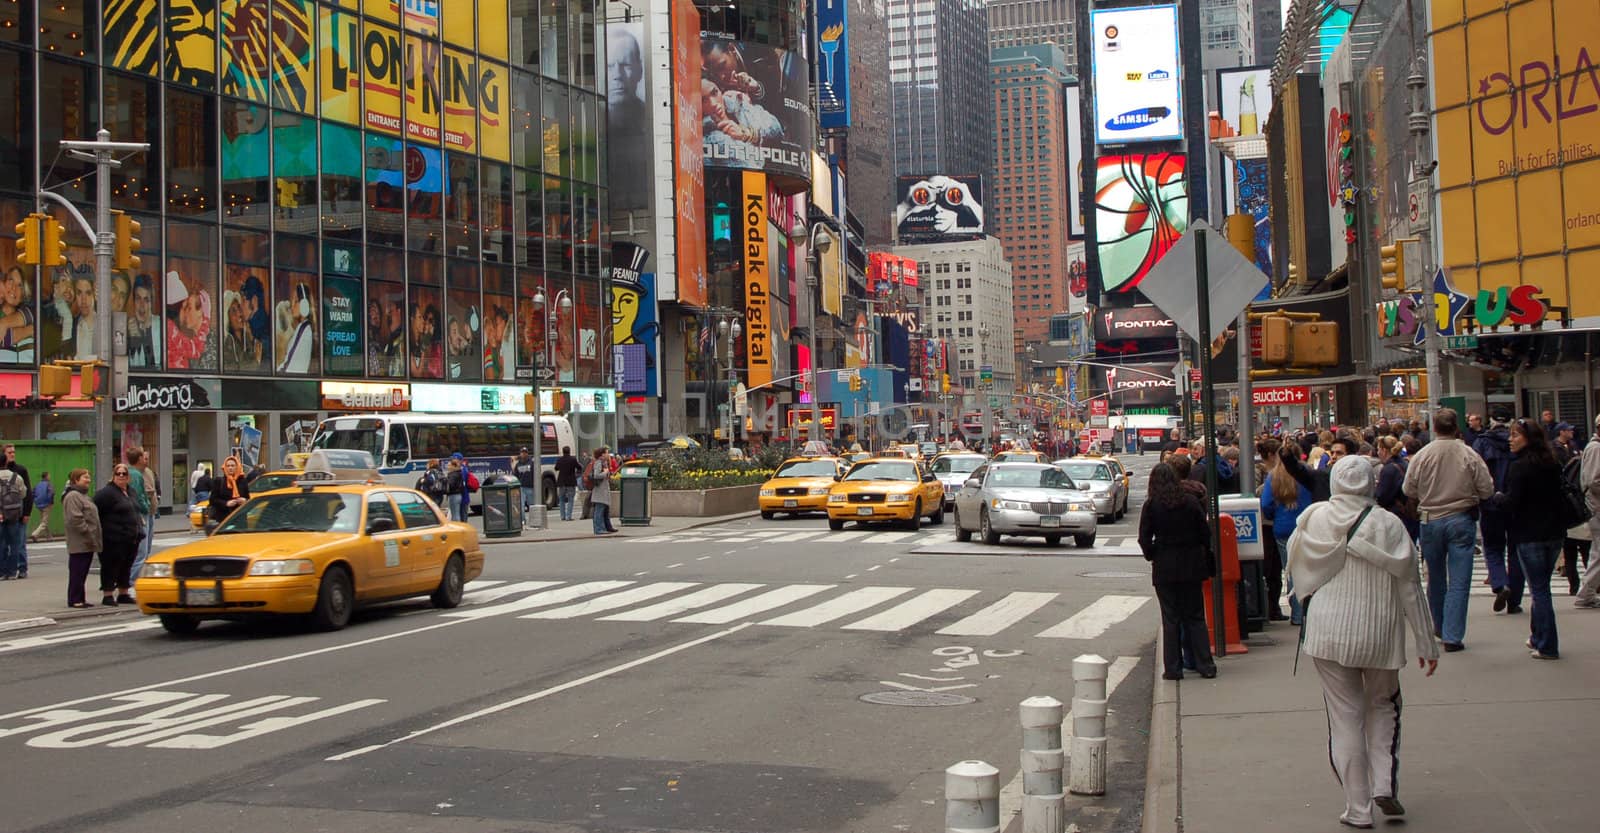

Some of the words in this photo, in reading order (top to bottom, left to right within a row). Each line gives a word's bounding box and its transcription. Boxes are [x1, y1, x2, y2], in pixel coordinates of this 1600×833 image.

[331, 11, 415, 92] LION
[421, 28, 499, 116] KING
[367, 112, 400, 129] ENTRANCE
[408, 123, 420, 135] ON
[422, 126, 438, 138] 45TH
[444, 132, 463, 145] STREET
[1498, 155, 1525, 176] Bult
[1527, 152, 1544, 169] for
[746, 194, 765, 272] Kodak
[612, 266, 639, 282] PEANUT
[332, 297, 351, 306] STAY
[1475, 284, 1546, 326] US
[330, 311, 353, 322] WARM
[746, 282, 768, 365] digital
[1114, 319, 1175, 329] PONTIAC
[327, 331, 356, 342] SPREAD
[332, 345, 351, 355] LOVE
[1117, 379, 1176, 389] PONTIAC
[1253, 389, 1295, 403] swatch
